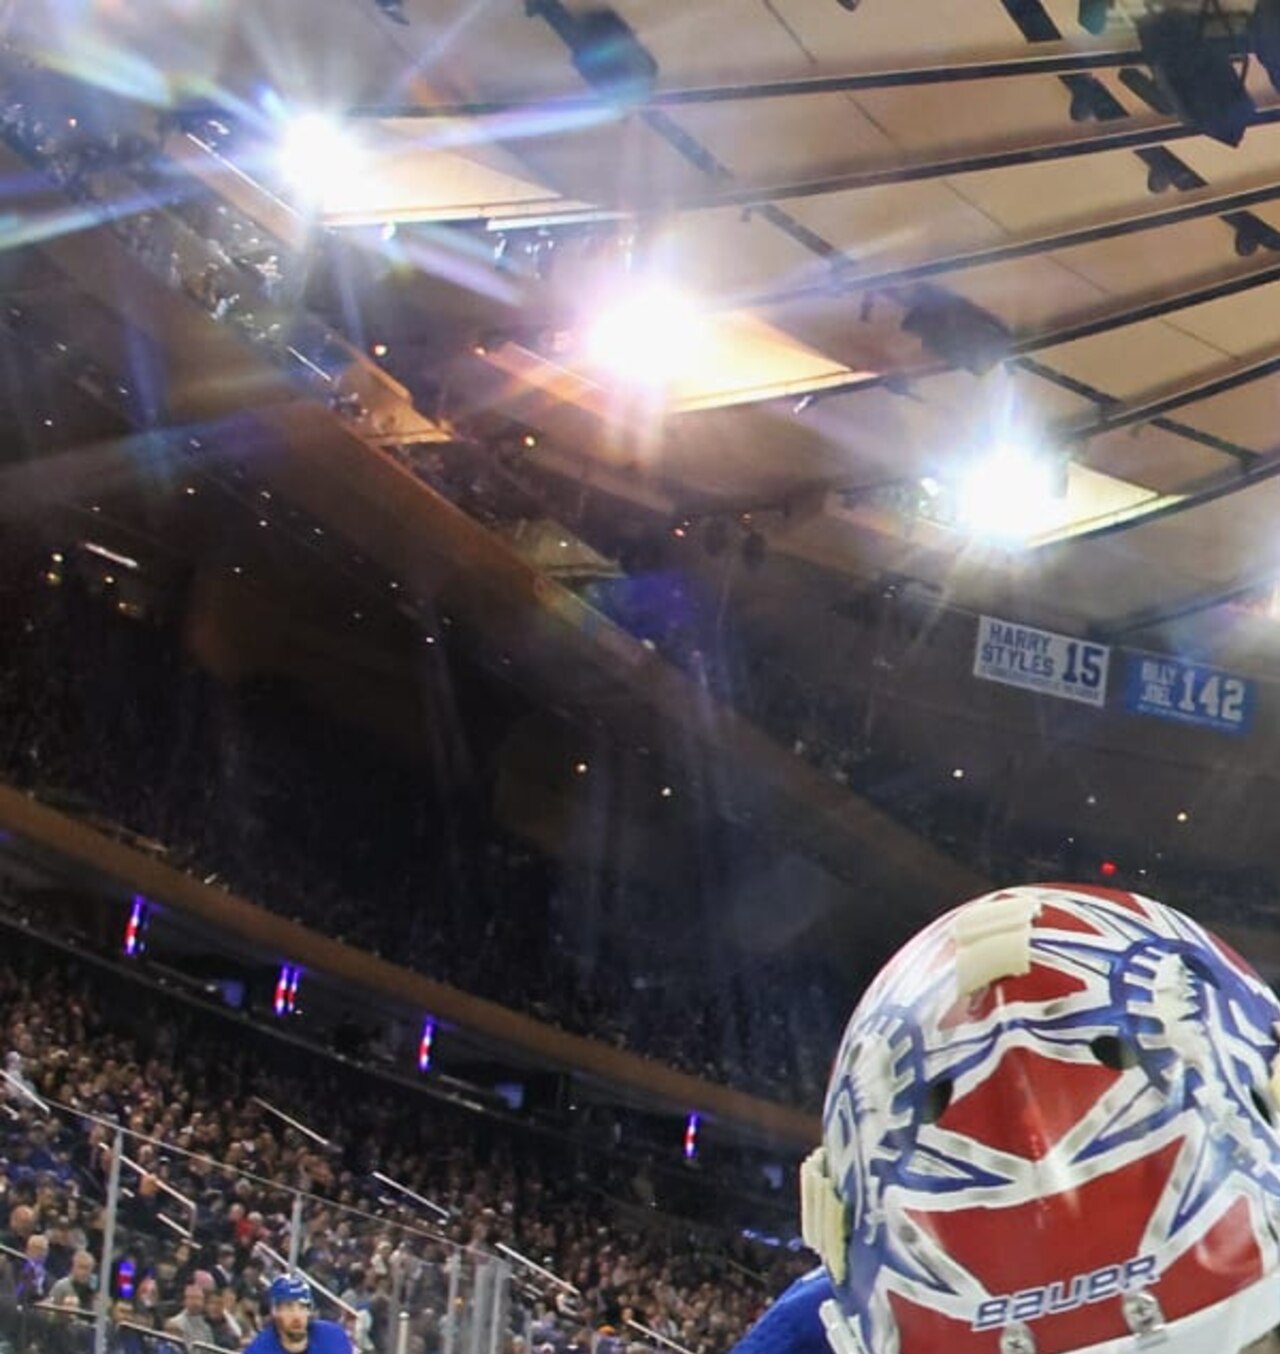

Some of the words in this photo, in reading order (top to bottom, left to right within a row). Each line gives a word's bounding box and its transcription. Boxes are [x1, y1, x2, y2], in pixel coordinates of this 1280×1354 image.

[981, 642, 1055, 677] STYLES
[989, 623, 1052, 652] HARRY
[1062, 642, 1105, 688] 15
[1178, 670, 1245, 723] 142
[970, 1255, 1160, 1330] BAUER
